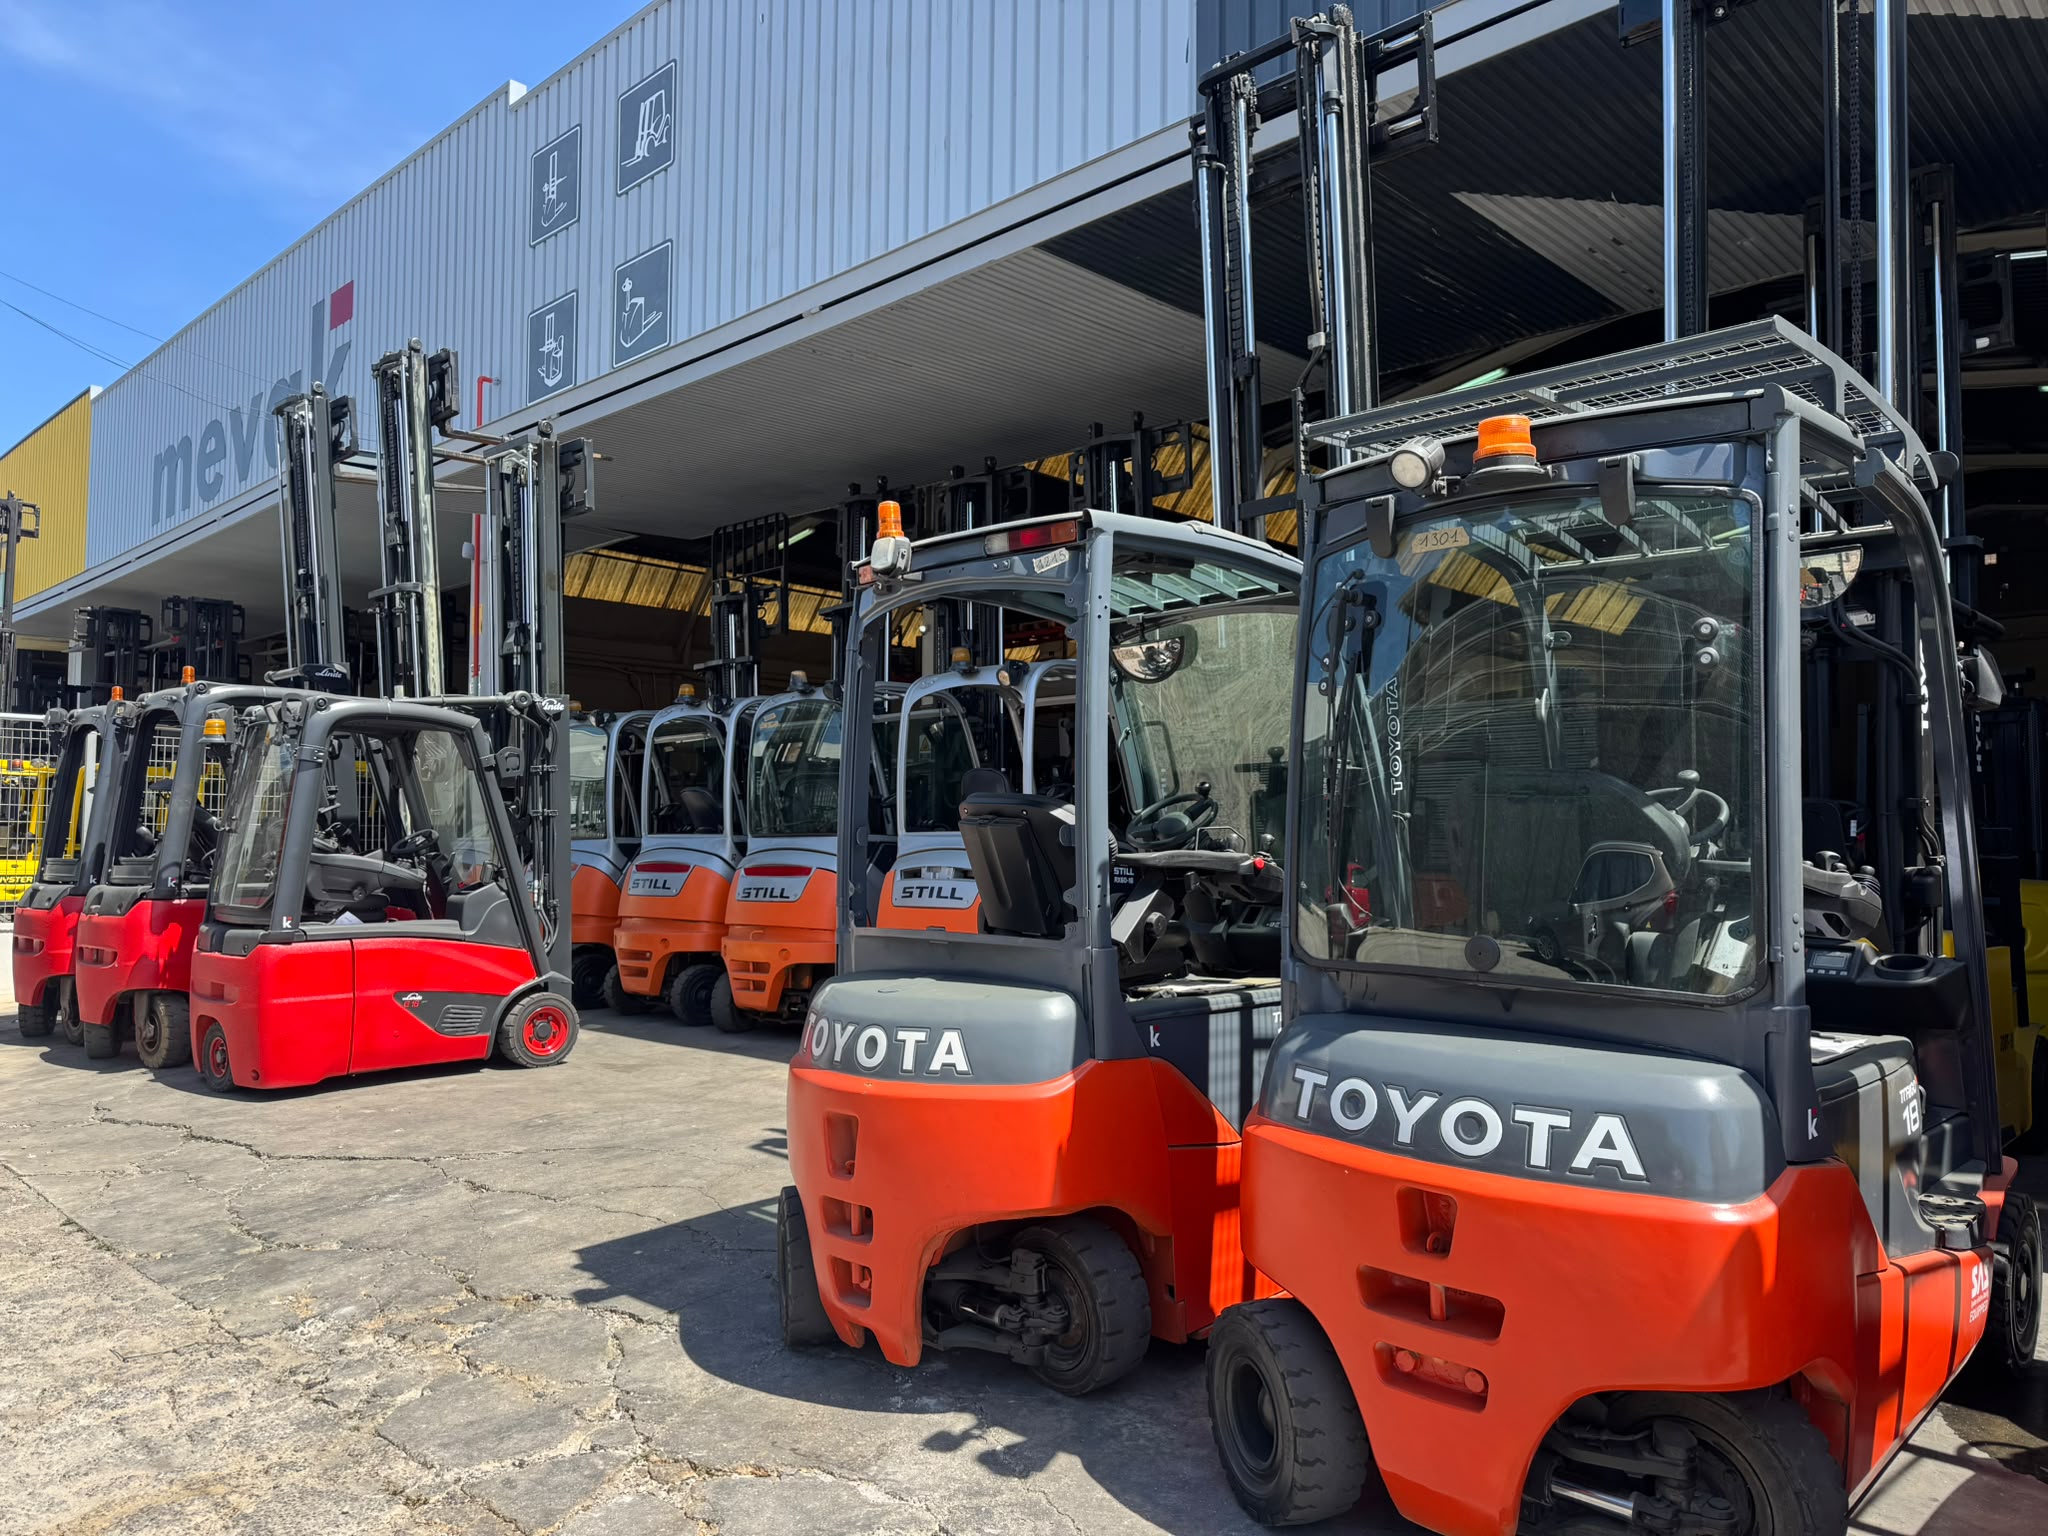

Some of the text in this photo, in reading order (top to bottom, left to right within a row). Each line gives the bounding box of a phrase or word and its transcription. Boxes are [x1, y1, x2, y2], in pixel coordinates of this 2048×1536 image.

[1419, 529, 1459, 548] 1301
[315, 667, 342, 678] Linde
[1386, 677, 1403, 796] TOYOTA
[1113, 866, 1135, 876] STILL
[631, 878, 672, 891] STILL
[741, 887, 791, 900] STILL
[901, 886, 964, 901] STILL
[803, 1012, 969, 1072] TOYOTA
[1150, 1024, 1161, 1048] k
[1294, 1067, 1646, 1178] TOYOTA
[1807, 1106, 1819, 1141] k
[1902, 1098, 1920, 1137] 18
